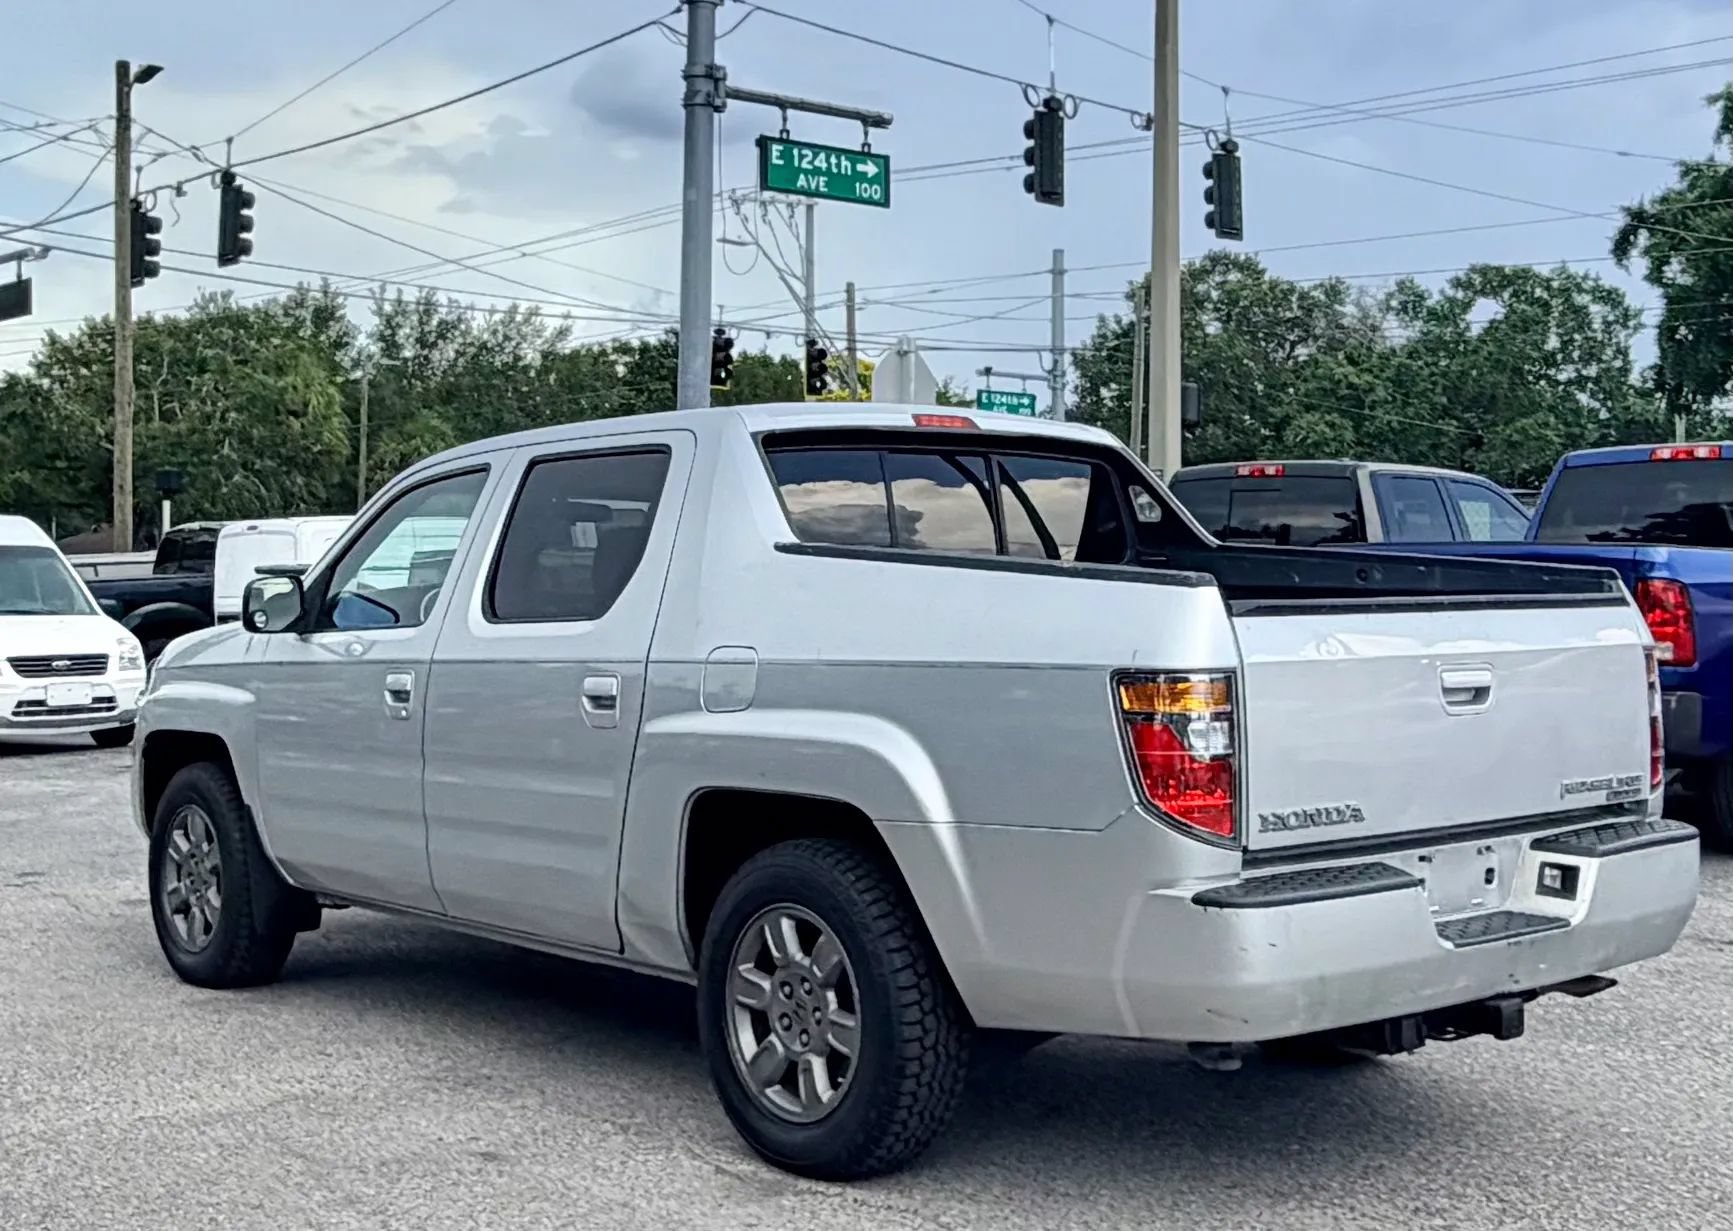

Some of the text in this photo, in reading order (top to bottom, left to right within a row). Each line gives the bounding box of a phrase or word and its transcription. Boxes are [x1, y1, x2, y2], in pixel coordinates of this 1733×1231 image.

[771, 143, 852, 176] E 124th
[796, 172, 881, 199] AVE 100
[981, 392, 989, 403] E
[1258, 803, 1366, 833] HONDA
